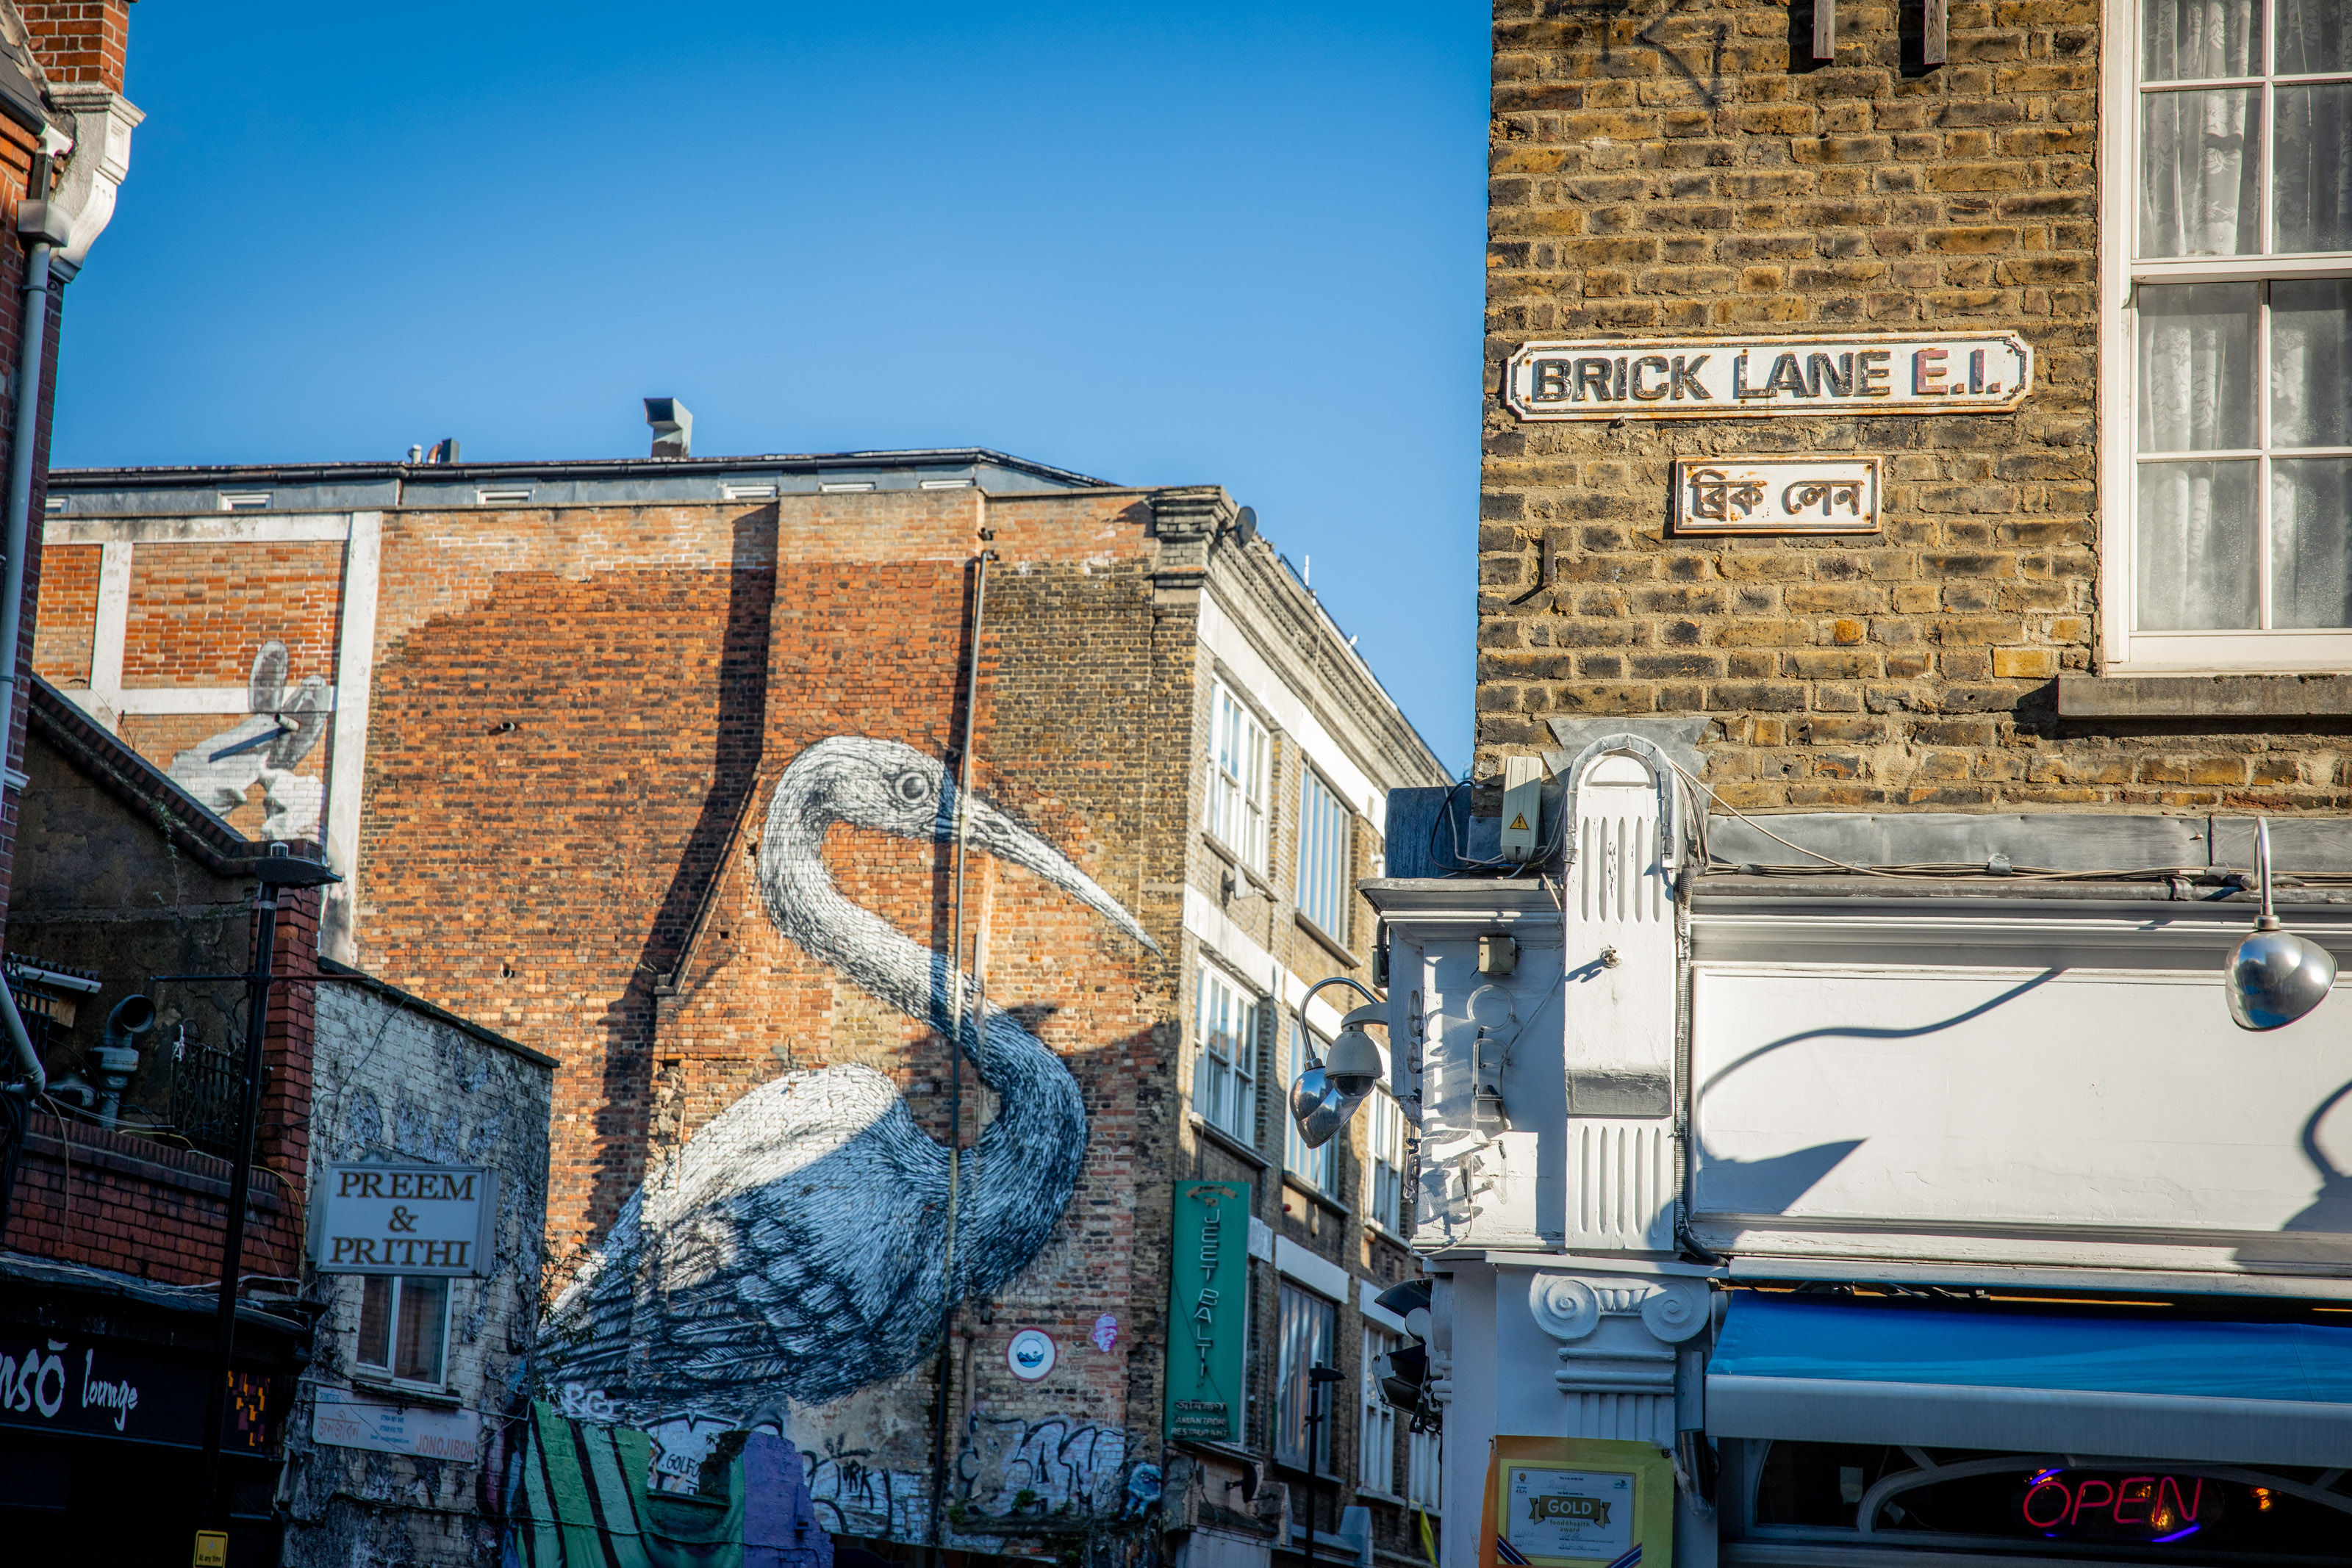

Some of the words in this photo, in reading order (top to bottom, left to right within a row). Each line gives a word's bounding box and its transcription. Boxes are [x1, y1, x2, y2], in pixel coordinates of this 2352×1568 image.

[1537, 355, 1713, 403] BRICK
[1737, 351, 1892, 398] LANE
[1782, 480, 1865, 516] লেন
[336, 1170, 478, 1201] PREEM
[387, 1205, 419, 1233] &
[329, 1237, 471, 1267] PRITHI
[82, 1348, 138, 1431] lounge
[416, 1434, 476, 1460] JONOJIBON
[1547, 1499, 1592, 1515] GOLD
[2023, 1476, 2203, 1528] OPEN
[1549, 1519, 1590, 1528] food4health
